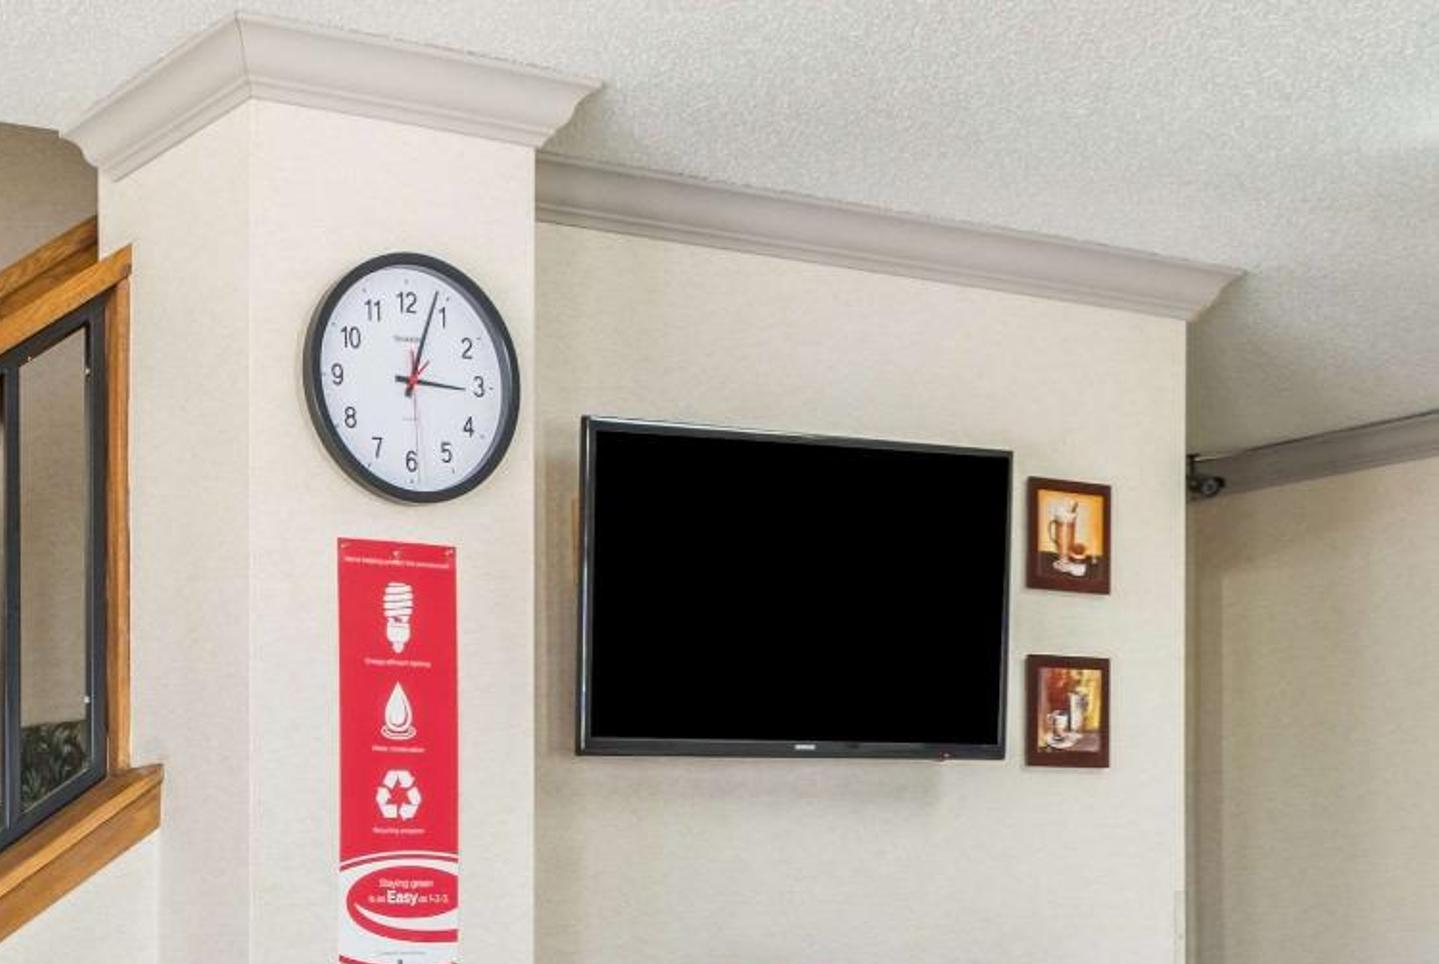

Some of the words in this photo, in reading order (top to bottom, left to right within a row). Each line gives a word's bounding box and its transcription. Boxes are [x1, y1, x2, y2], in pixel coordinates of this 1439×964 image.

[364, 300, 382, 322] 11
[396, 292, 417, 314] 12
[438, 307, 447, 328] 1
[341, 326, 361, 349] 10
[461, 338, 473, 360] 2
[331, 363, 344, 386] 9
[472, 376, 485, 398] 3
[344, 407, 357, 428] 8
[463, 417, 474, 438] 4
[371, 437, 383, 458] 7
[440, 443, 453, 463] 5
[405, 451, 417, 472] 6
[387, 890, 418, 907] Easy
